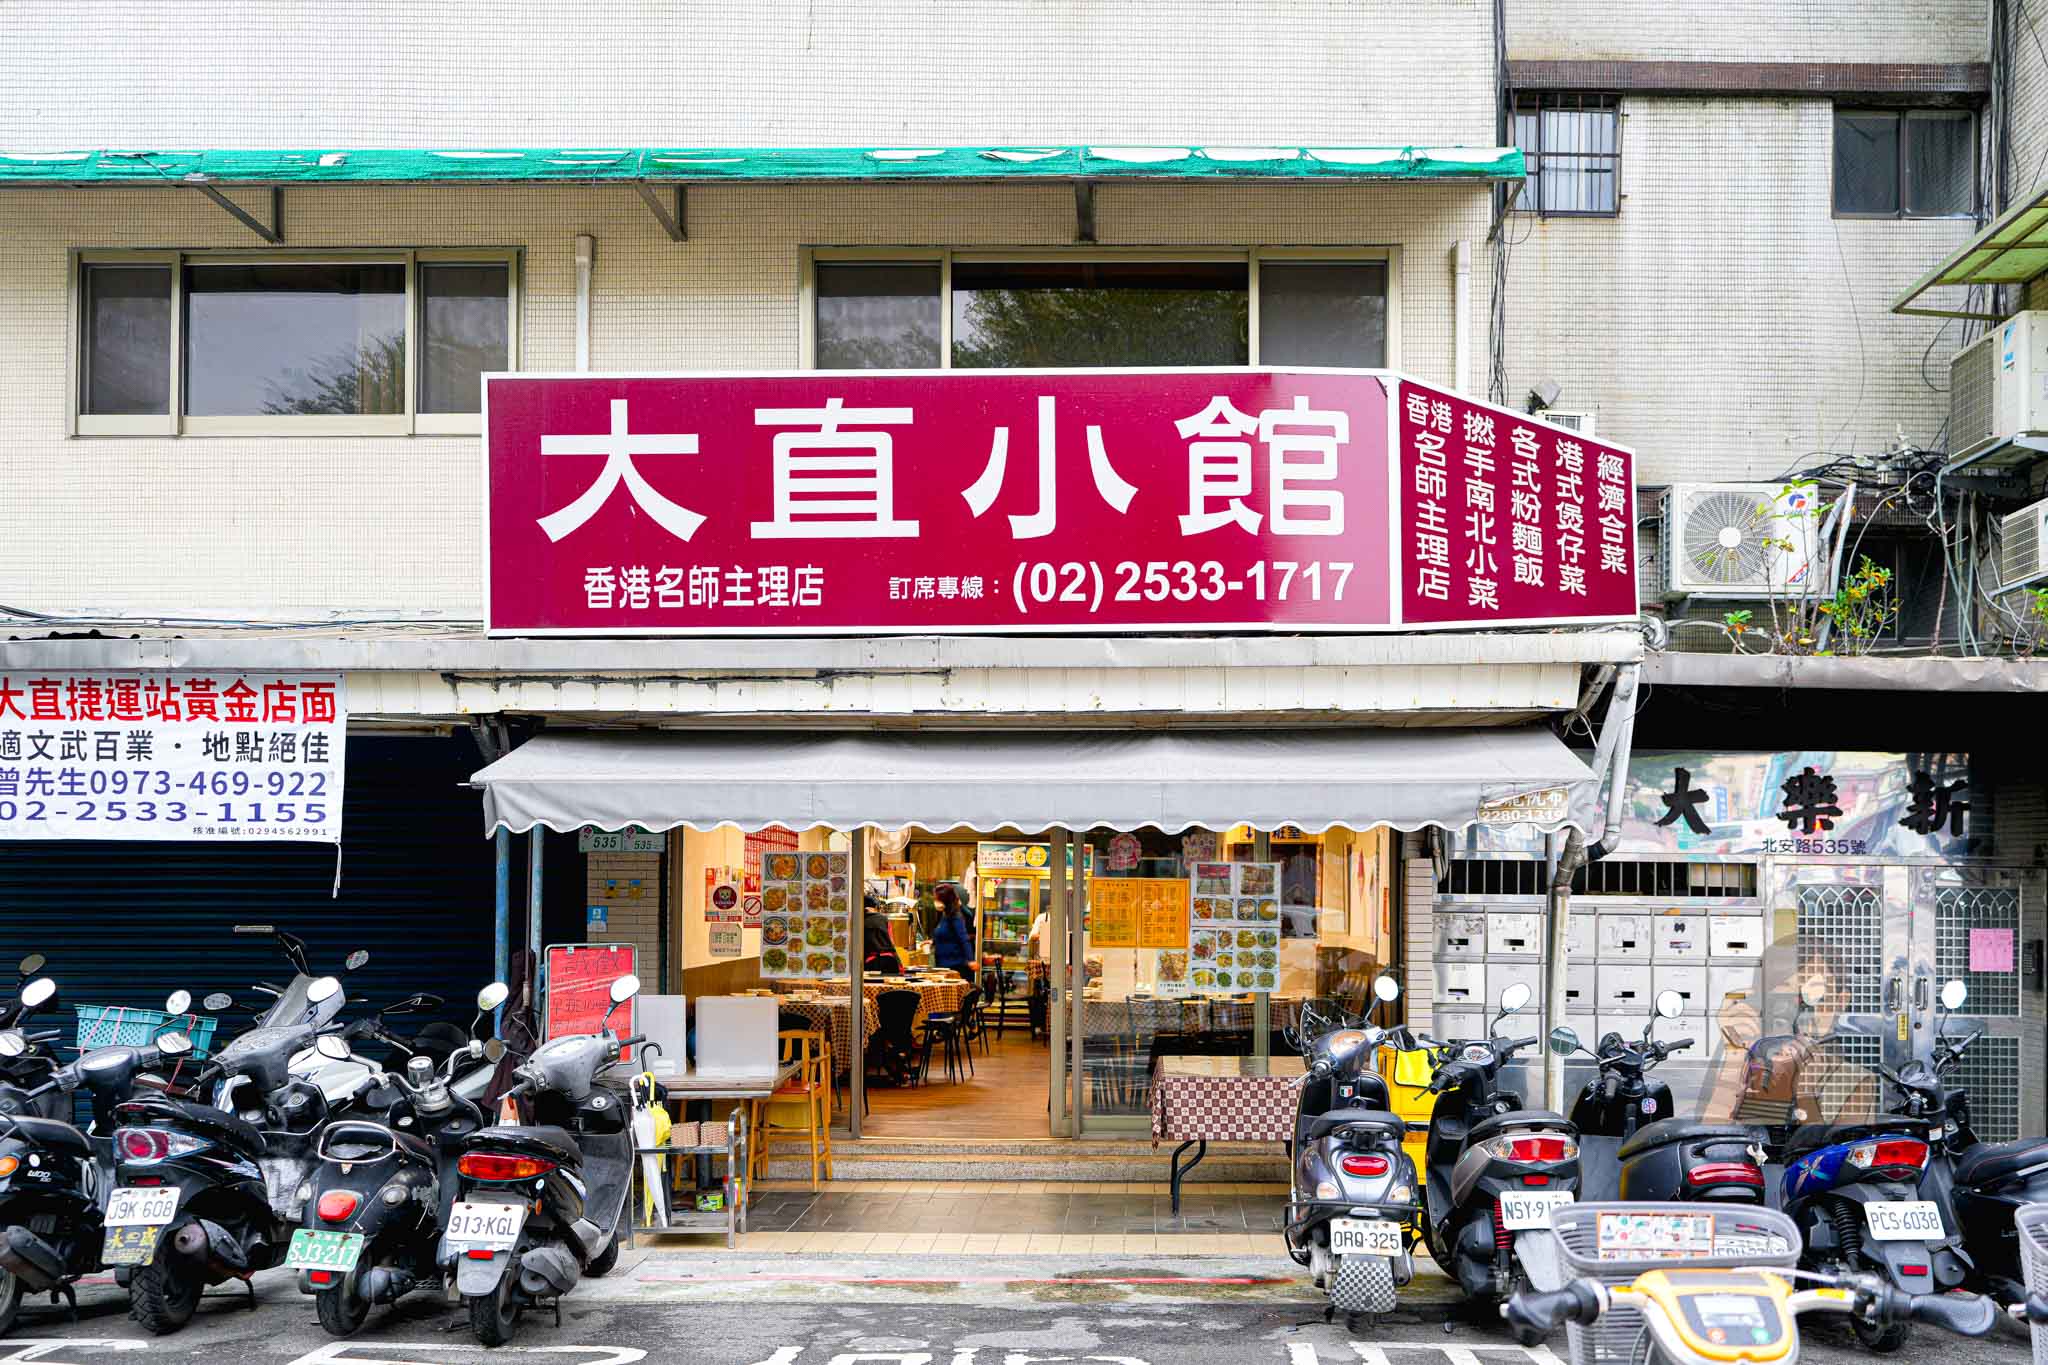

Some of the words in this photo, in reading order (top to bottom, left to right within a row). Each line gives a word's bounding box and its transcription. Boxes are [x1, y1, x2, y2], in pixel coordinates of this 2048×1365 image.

[536, 395, 1350, 543] 大直小館
[1406, 392, 1452, 601] 香港名師主理店
[1510, 426, 1545, 588] 各式粉麵飯
[1555, 438, 1588, 597] 港式煲仔菜
[1596, 452, 1628, 575] 經濟合菜
[583, 565, 824, 609] 香港名師主理店
[1013, 562, 1103, 613] (02)
[1114, 560, 1355, 602] 2533-1717
[0, 677, 337, 725] 大直捷運站黃金店面
[0, 766, 327, 797] 曾先生0973-469-922
[0, 800, 327, 823] 02-2533-1155
[593, 836, 617, 848] 535
[1761, 838, 1867, 855] 北安路535號
